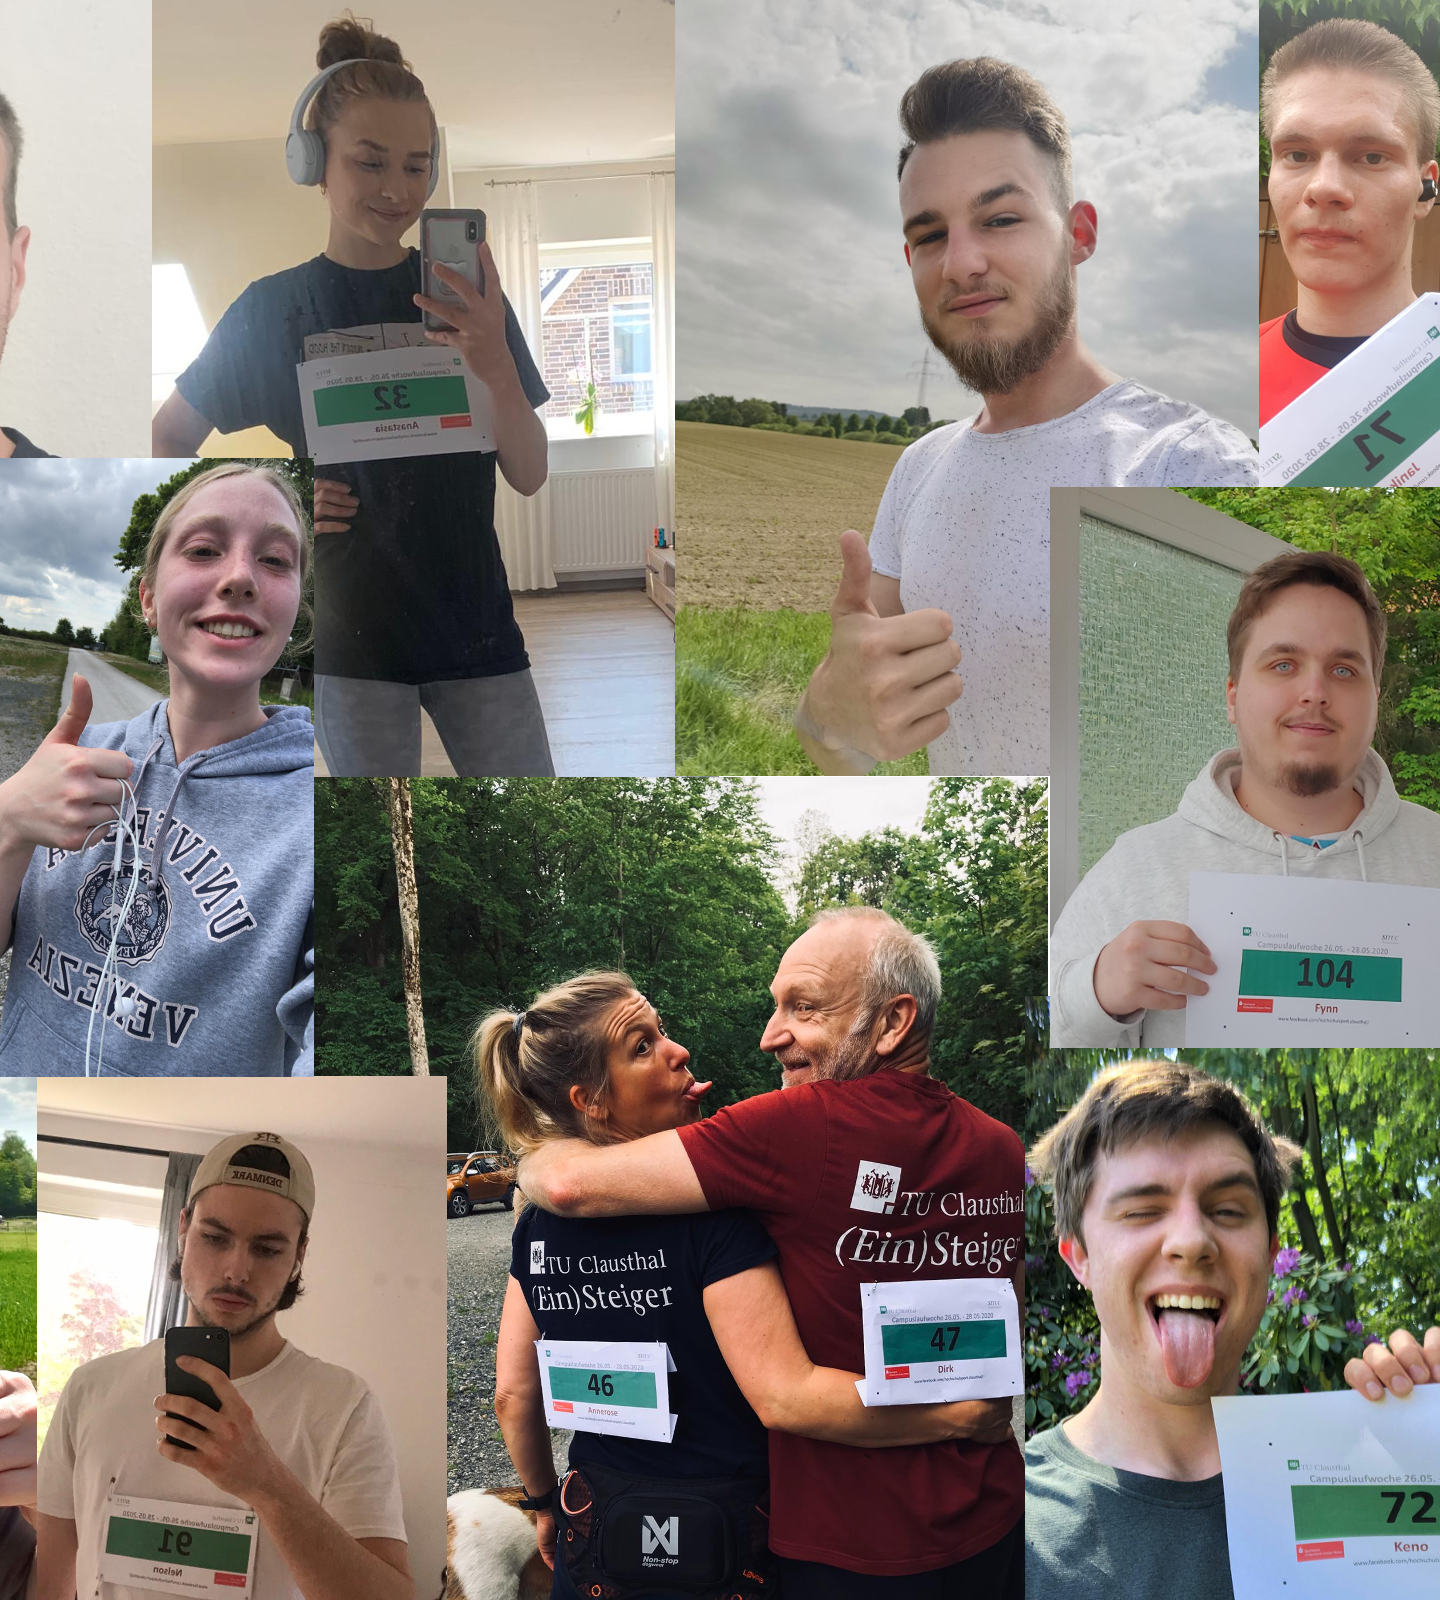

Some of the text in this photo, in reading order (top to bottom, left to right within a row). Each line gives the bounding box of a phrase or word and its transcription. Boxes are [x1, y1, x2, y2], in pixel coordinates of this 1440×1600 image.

[1257, 941, 1388, 955] Campuslaufwoche 26.05. 28.05.2020
[1297, 958, 1354, 988] 104
[1314, 1003, 1338, 1014] Fynn
[900, 1189, 1024, 1217] TU Clausthal
[546, 1249, 668, 1275] TU Clausthal
[892, 1315, 944, 1324] Campuslaufwoche
[930, 1326, 960, 1352] 47
[938, 1364, 954, 1374] Dirk
[588, 1374, 614, 1396] 46
[588, 1407, 618, 1416] Annerose
[1314, 1464, 1351, 1472] Clausthal
[1310, 1474, 1402, 1484] Campuslaufwoche
[1404, 1474, 1436, 1483] 26.05.
[1380, 1491, 1436, 1524] 72
[1394, 1541, 1429, 1552] Keno
[642, 1556, 679, 1566] Non-stop
